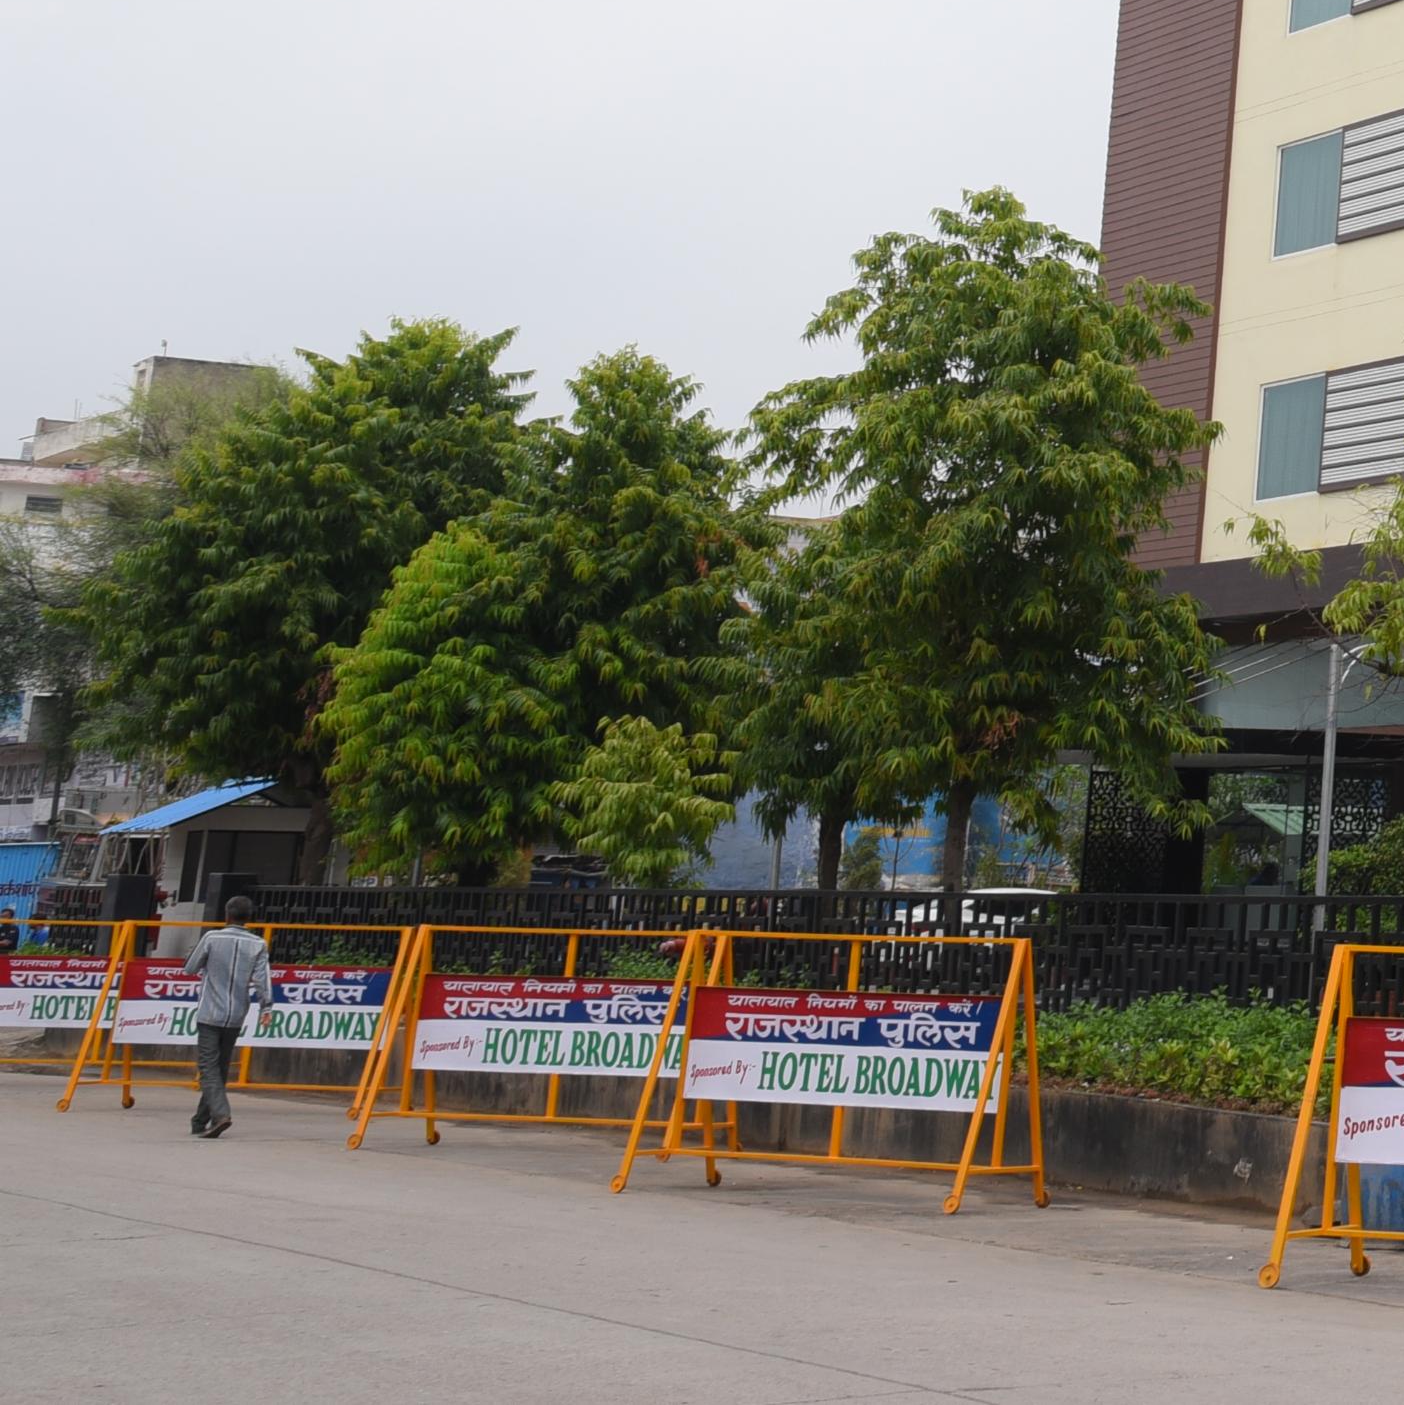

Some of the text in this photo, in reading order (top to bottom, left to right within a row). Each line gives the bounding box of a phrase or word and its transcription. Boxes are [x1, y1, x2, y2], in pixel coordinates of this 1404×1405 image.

[281, 979, 368, 1004] पुलिस
[443, 980, 516, 995] यातायात
[581, 983, 604, 994] का
[608, 983, 657, 996] पालन
[728, 993, 799, 1009] यातायात
[806, 993, 859, 1010] नियमों
[863, 999, 886, 1012] का
[891, 999, 940, 1014] पालन
[443, 995, 571, 1019] राजस्थान
[582, 993, 680, 1024] पुलिस
[253, 1009, 381, 1041] BROADWAY
[725, 1011, 982, 1049] राजस्थान पुलिस
[419, 1040, 461, 1061] Sponsored
[481, 1028, 566, 1066] HOTEL
[567, 1030, 685, 1070] BROADW
[689, 1059, 734, 1087] Sponsored
[757, 1050, 850, 1095] HOTEL
